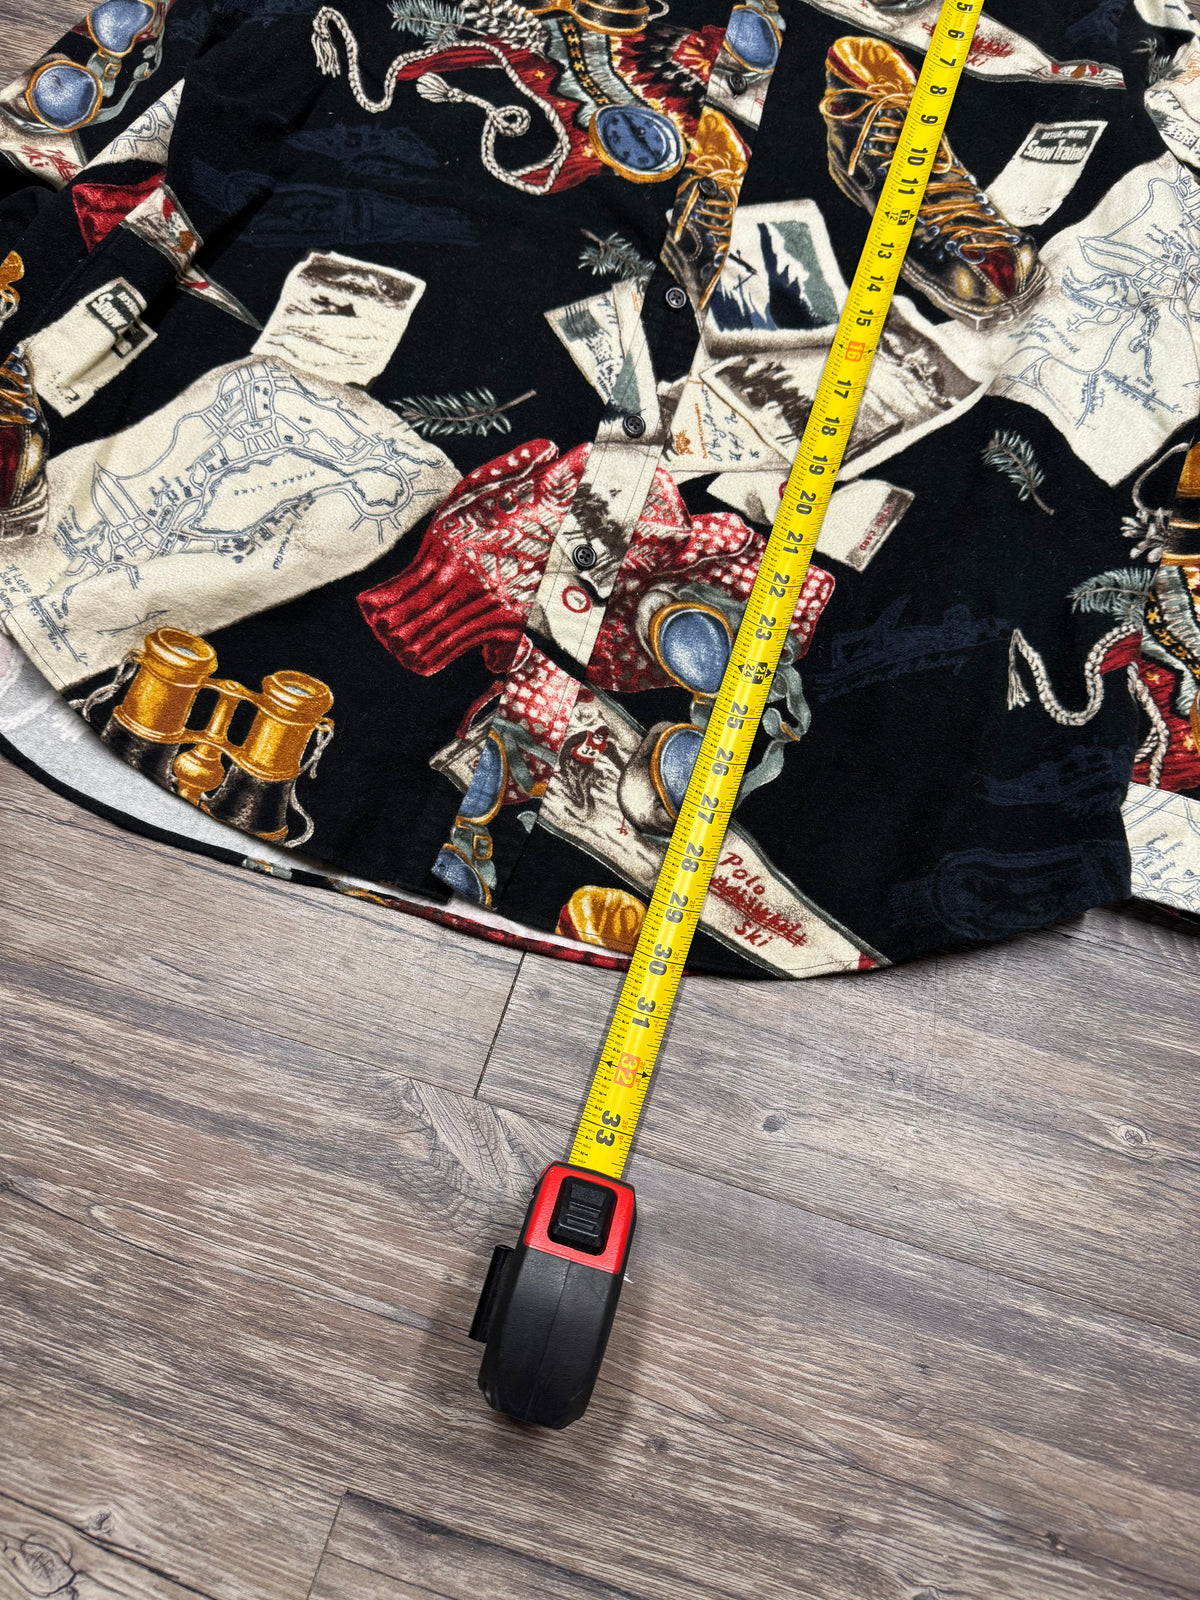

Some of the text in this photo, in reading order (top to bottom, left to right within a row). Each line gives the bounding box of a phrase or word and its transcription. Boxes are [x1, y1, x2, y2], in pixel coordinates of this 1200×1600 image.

[957, 2, 973, 11] 5
[948, 29, 964, 39] 6
[940, 57, 956, 66] 7
[930, 85, 947, 95] 8
[921, 114, 938, 124] 9
[908, 147, 928, 166] 10
[1023, 139, 1057, 160] Snow
[898, 178, 919, 194] 11
[878, 242, 894, 259] 13
[867, 275, 884, 292] 14
[91, 293, 128, 328] Snow
[856, 309, 873, 327] 15
[846, 342, 863, 360] 16
[834, 380, 852, 399] 17
[821, 417, 840, 436] 18
[809, 455, 828, 475] 19
[233, 470, 316, 496] MIRROR LAKE
[796, 490, 816, 515] 20
[783, 530, 803, 554] 21
[859, 530, 876, 551] CARD
[768, 572, 790, 598] 22
[755, 614, 776, 641] 23
[744, 663, 756, 678] 24
[756, 665, 766, 681] 2F
[727, 701, 748, 730] 25
[581, 746, 595, 757] 34
[711, 747, 734, 776] 26
[697, 793, 719, 825] 27
[681, 842, 704, 873] 28
[719, 852, 765, 895] Polo
[665, 891, 689, 924] 29
[734, 921, 773, 947] Ski
[649, 943, 672, 976] 30
[632, 997, 656, 1028] 31
[616, 1055, 638, 1086] 32
[595, 1110, 621, 1147] 33
